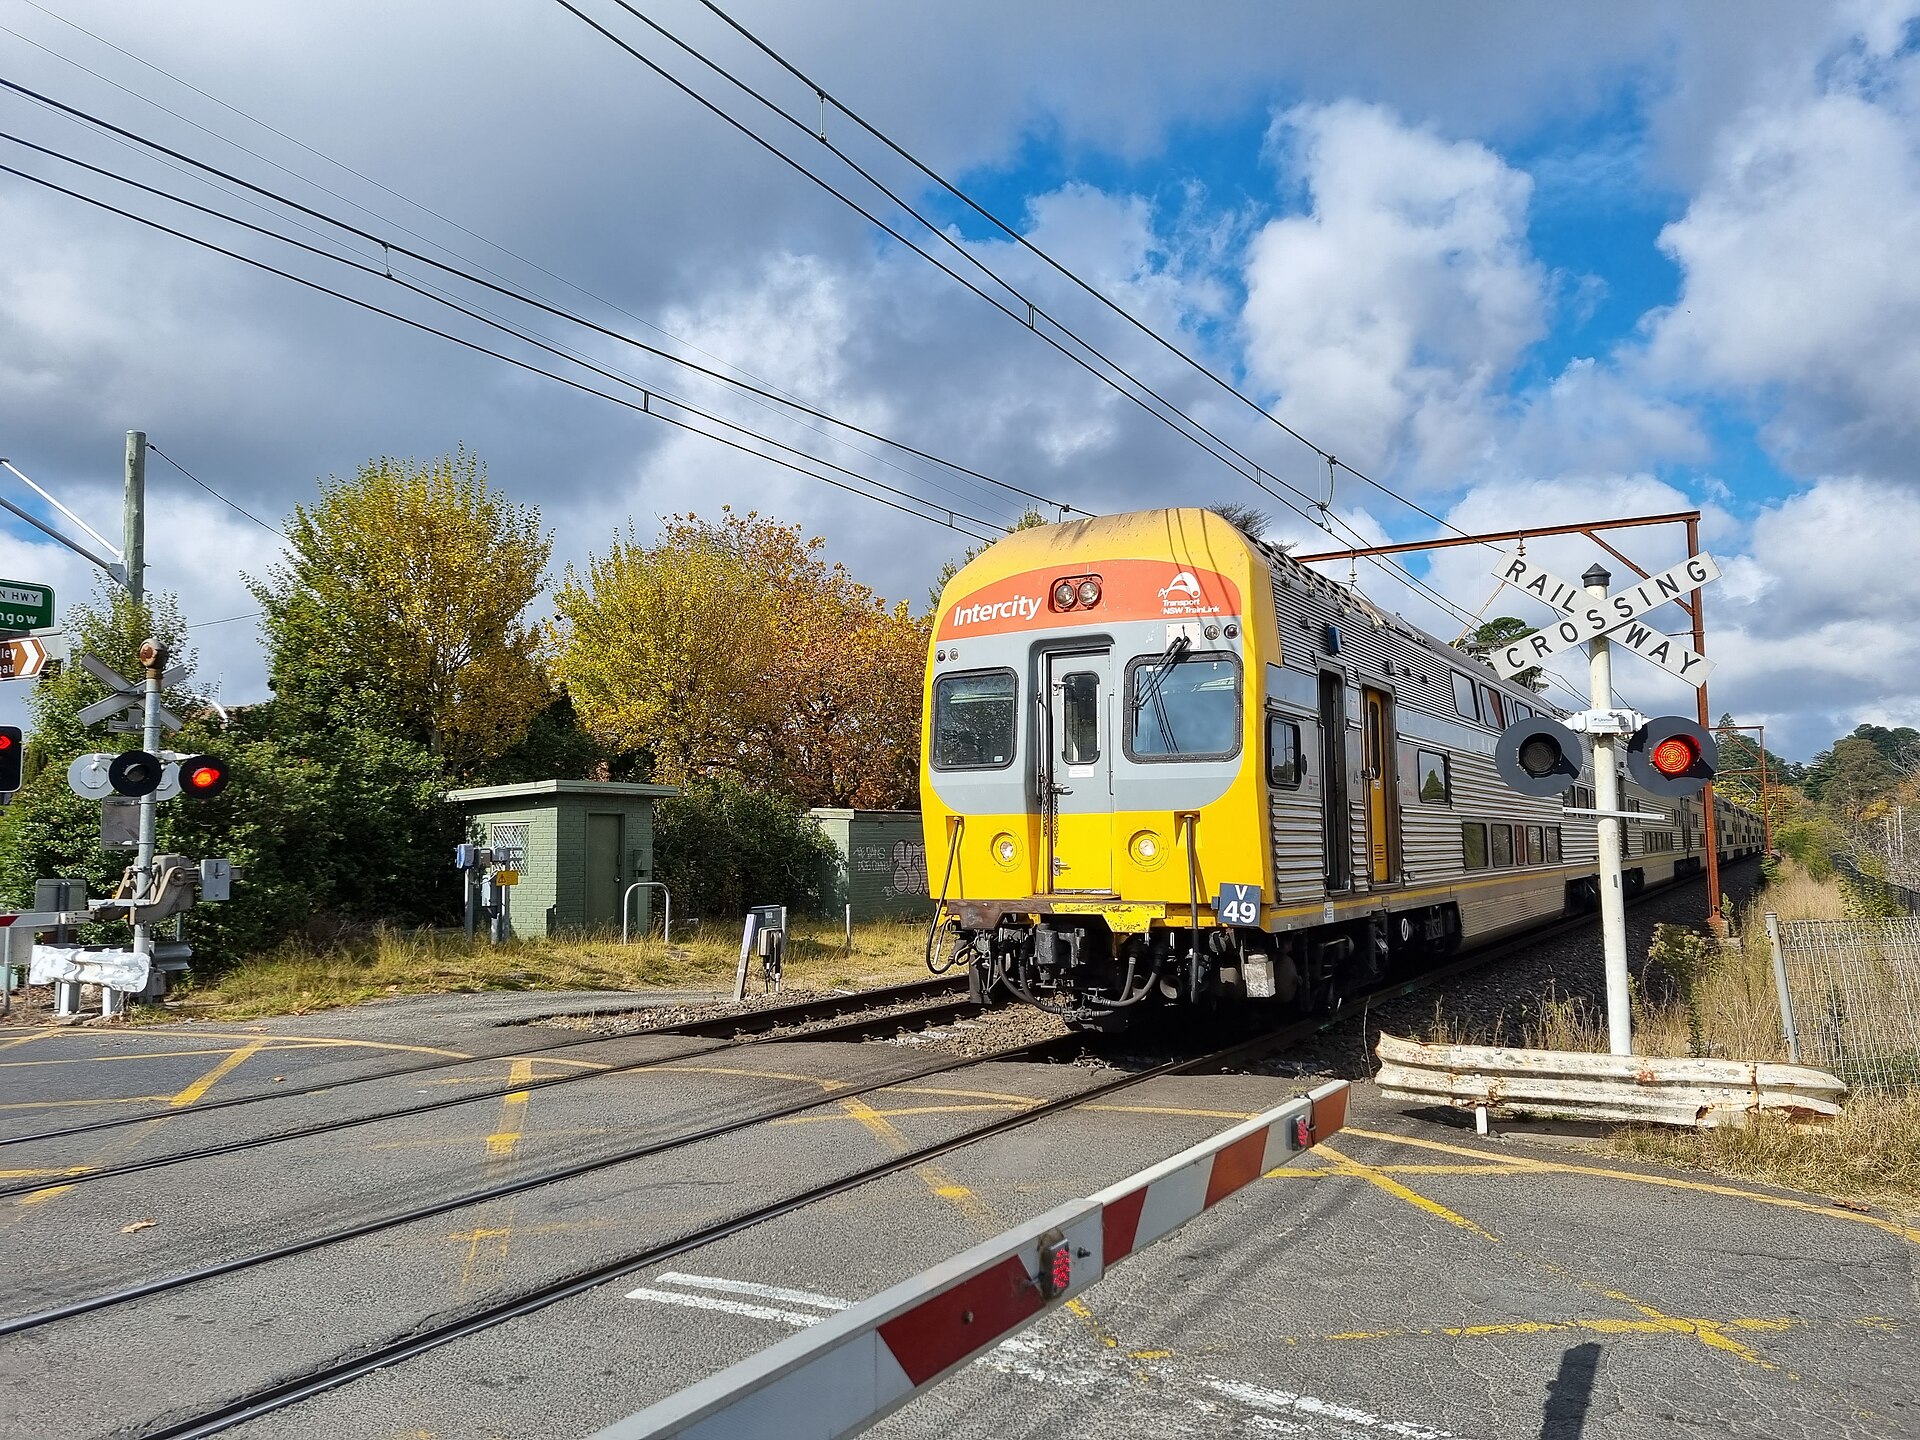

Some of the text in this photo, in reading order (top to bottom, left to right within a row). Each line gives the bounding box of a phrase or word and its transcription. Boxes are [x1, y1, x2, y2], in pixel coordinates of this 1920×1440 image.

[11, 591, 39, 602] HWY
[1163, 599, 1200, 607] Transport
[953, 595, 1042, 627] Intercity
[1163, 606, 1220, 615] NSW TrainLink
[1504, 558, 1702, 675] RAIL WAY
[1505, 560, 1708, 669] CROSSING
[1234, 884, 1249, 901] V
[1223, 900, 1257, 924] 49
